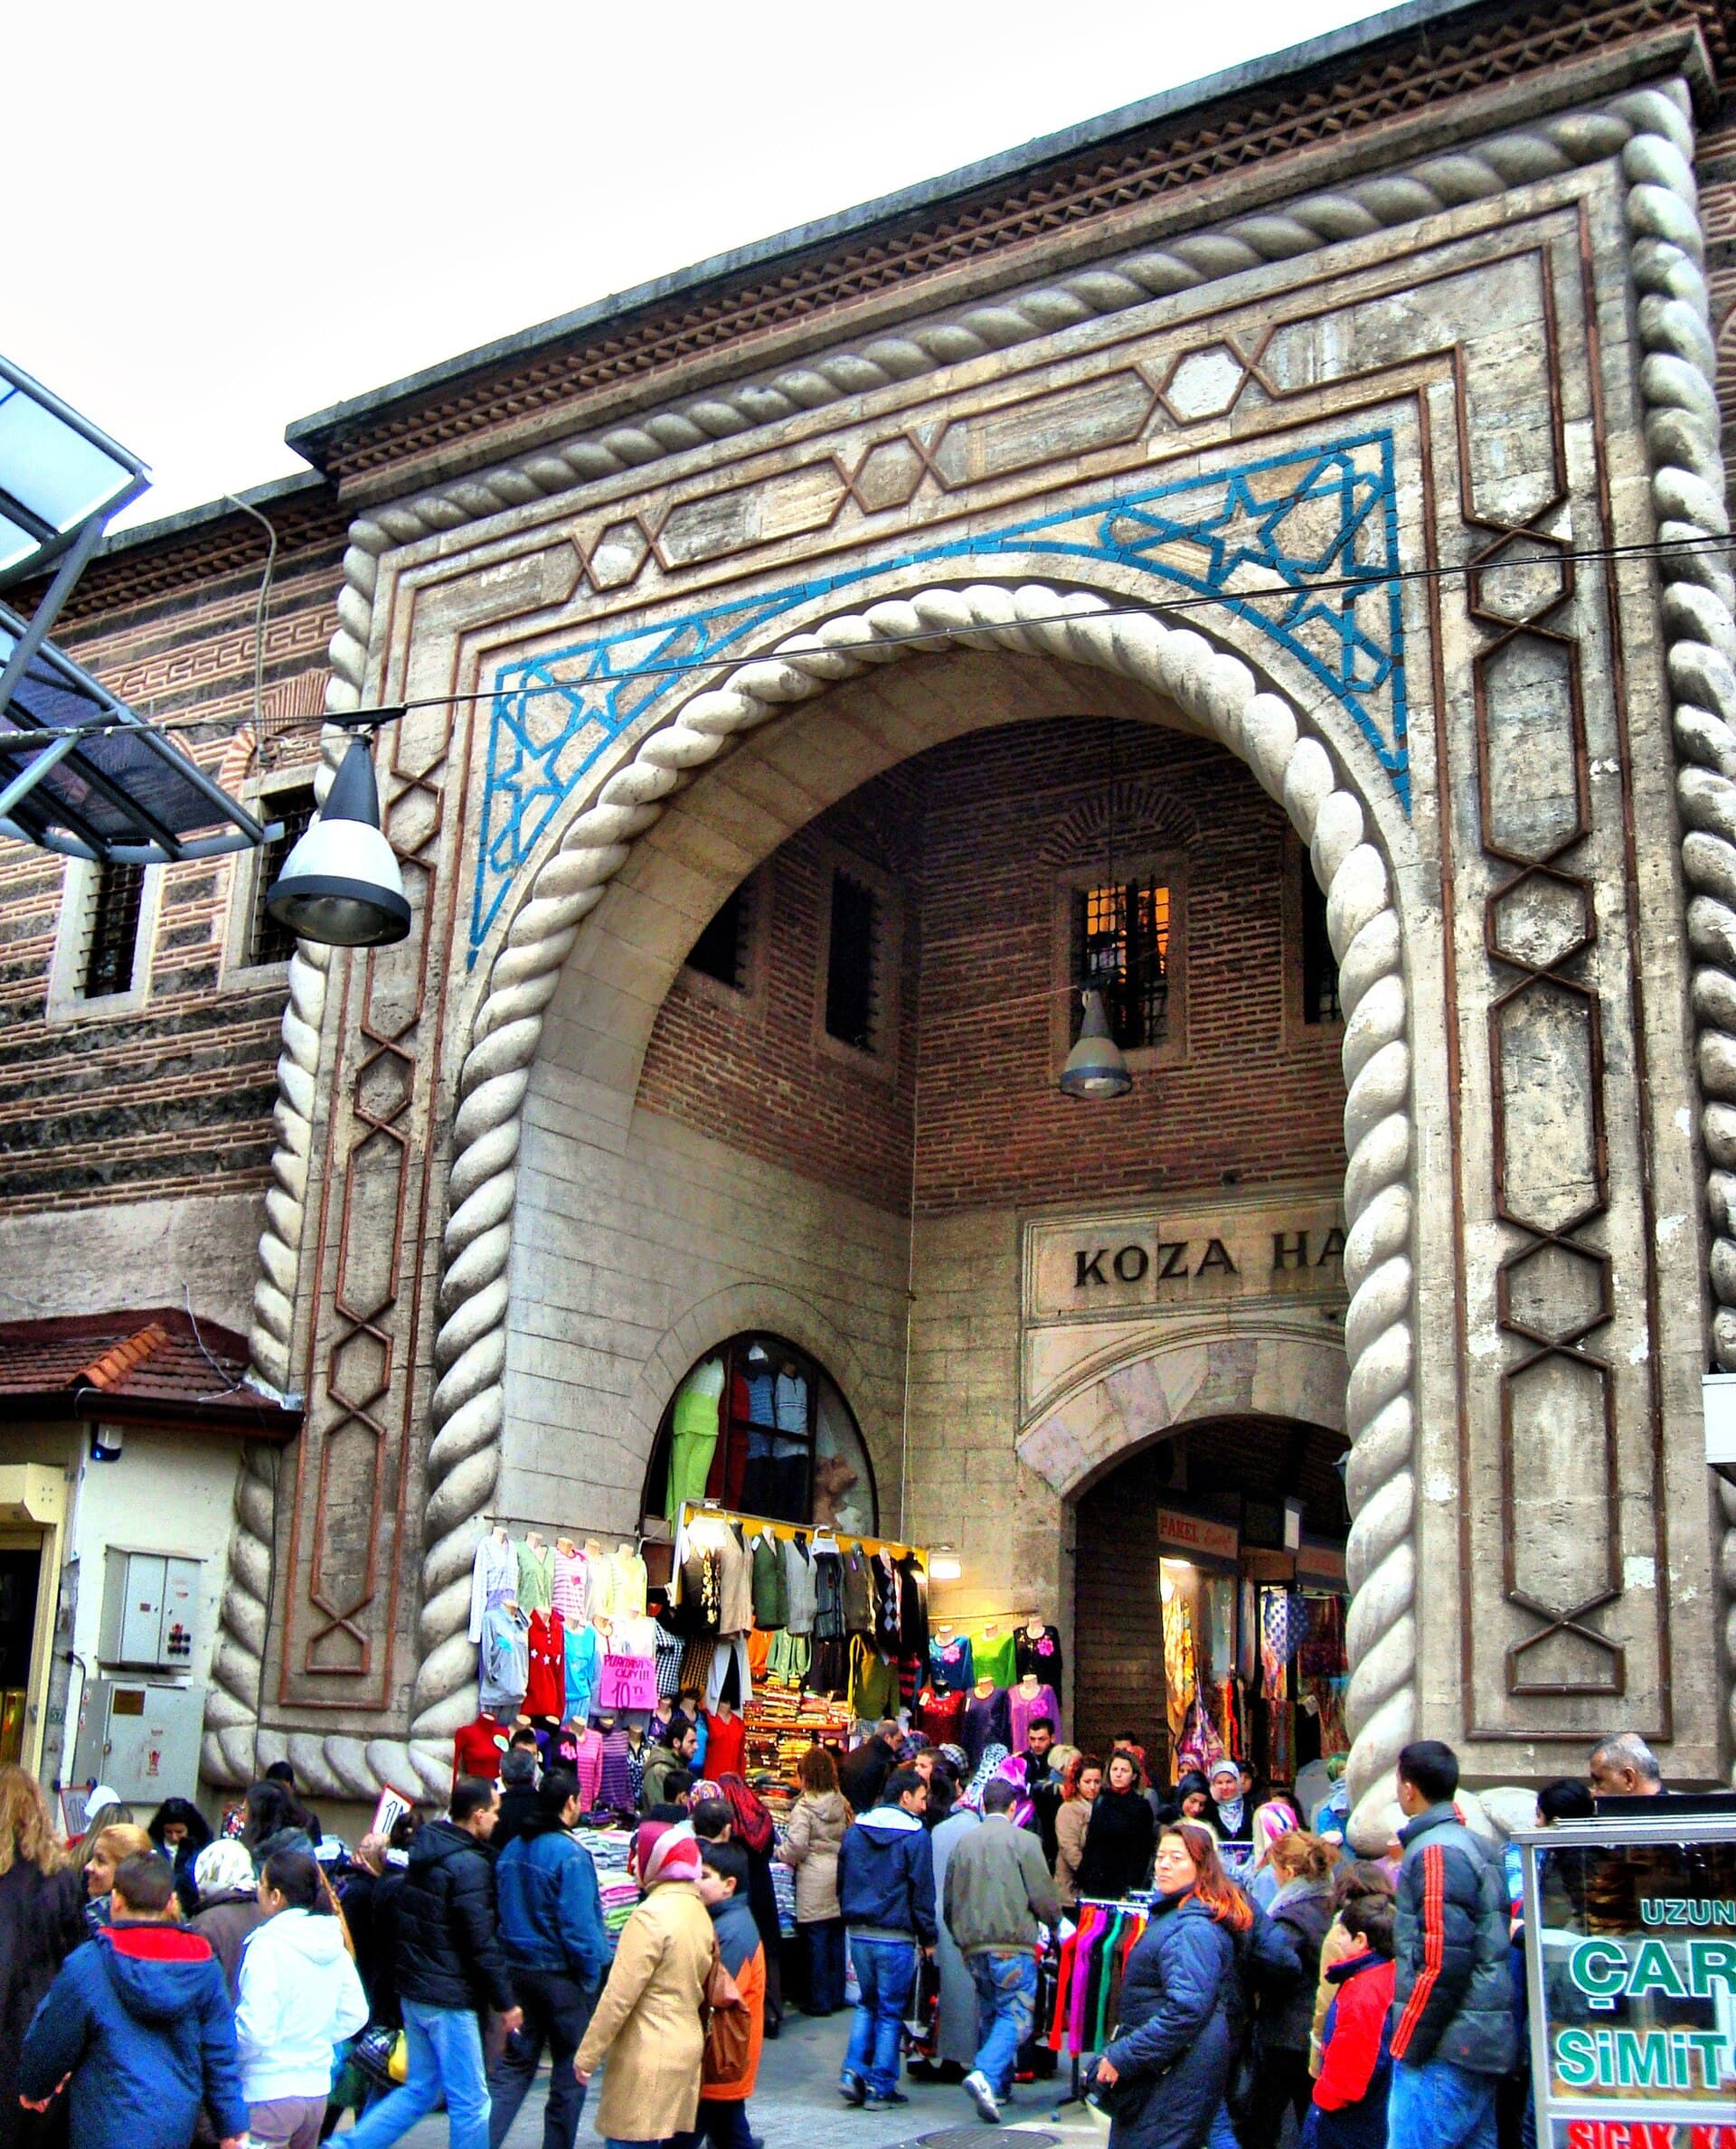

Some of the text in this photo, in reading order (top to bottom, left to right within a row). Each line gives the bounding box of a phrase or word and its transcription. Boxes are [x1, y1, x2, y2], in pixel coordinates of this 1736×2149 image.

[1074, 1238, 1241, 1287] KOZA
[610, 1681, 630, 1709] 10
[1641, 1899, 1736, 1926] UZUN
